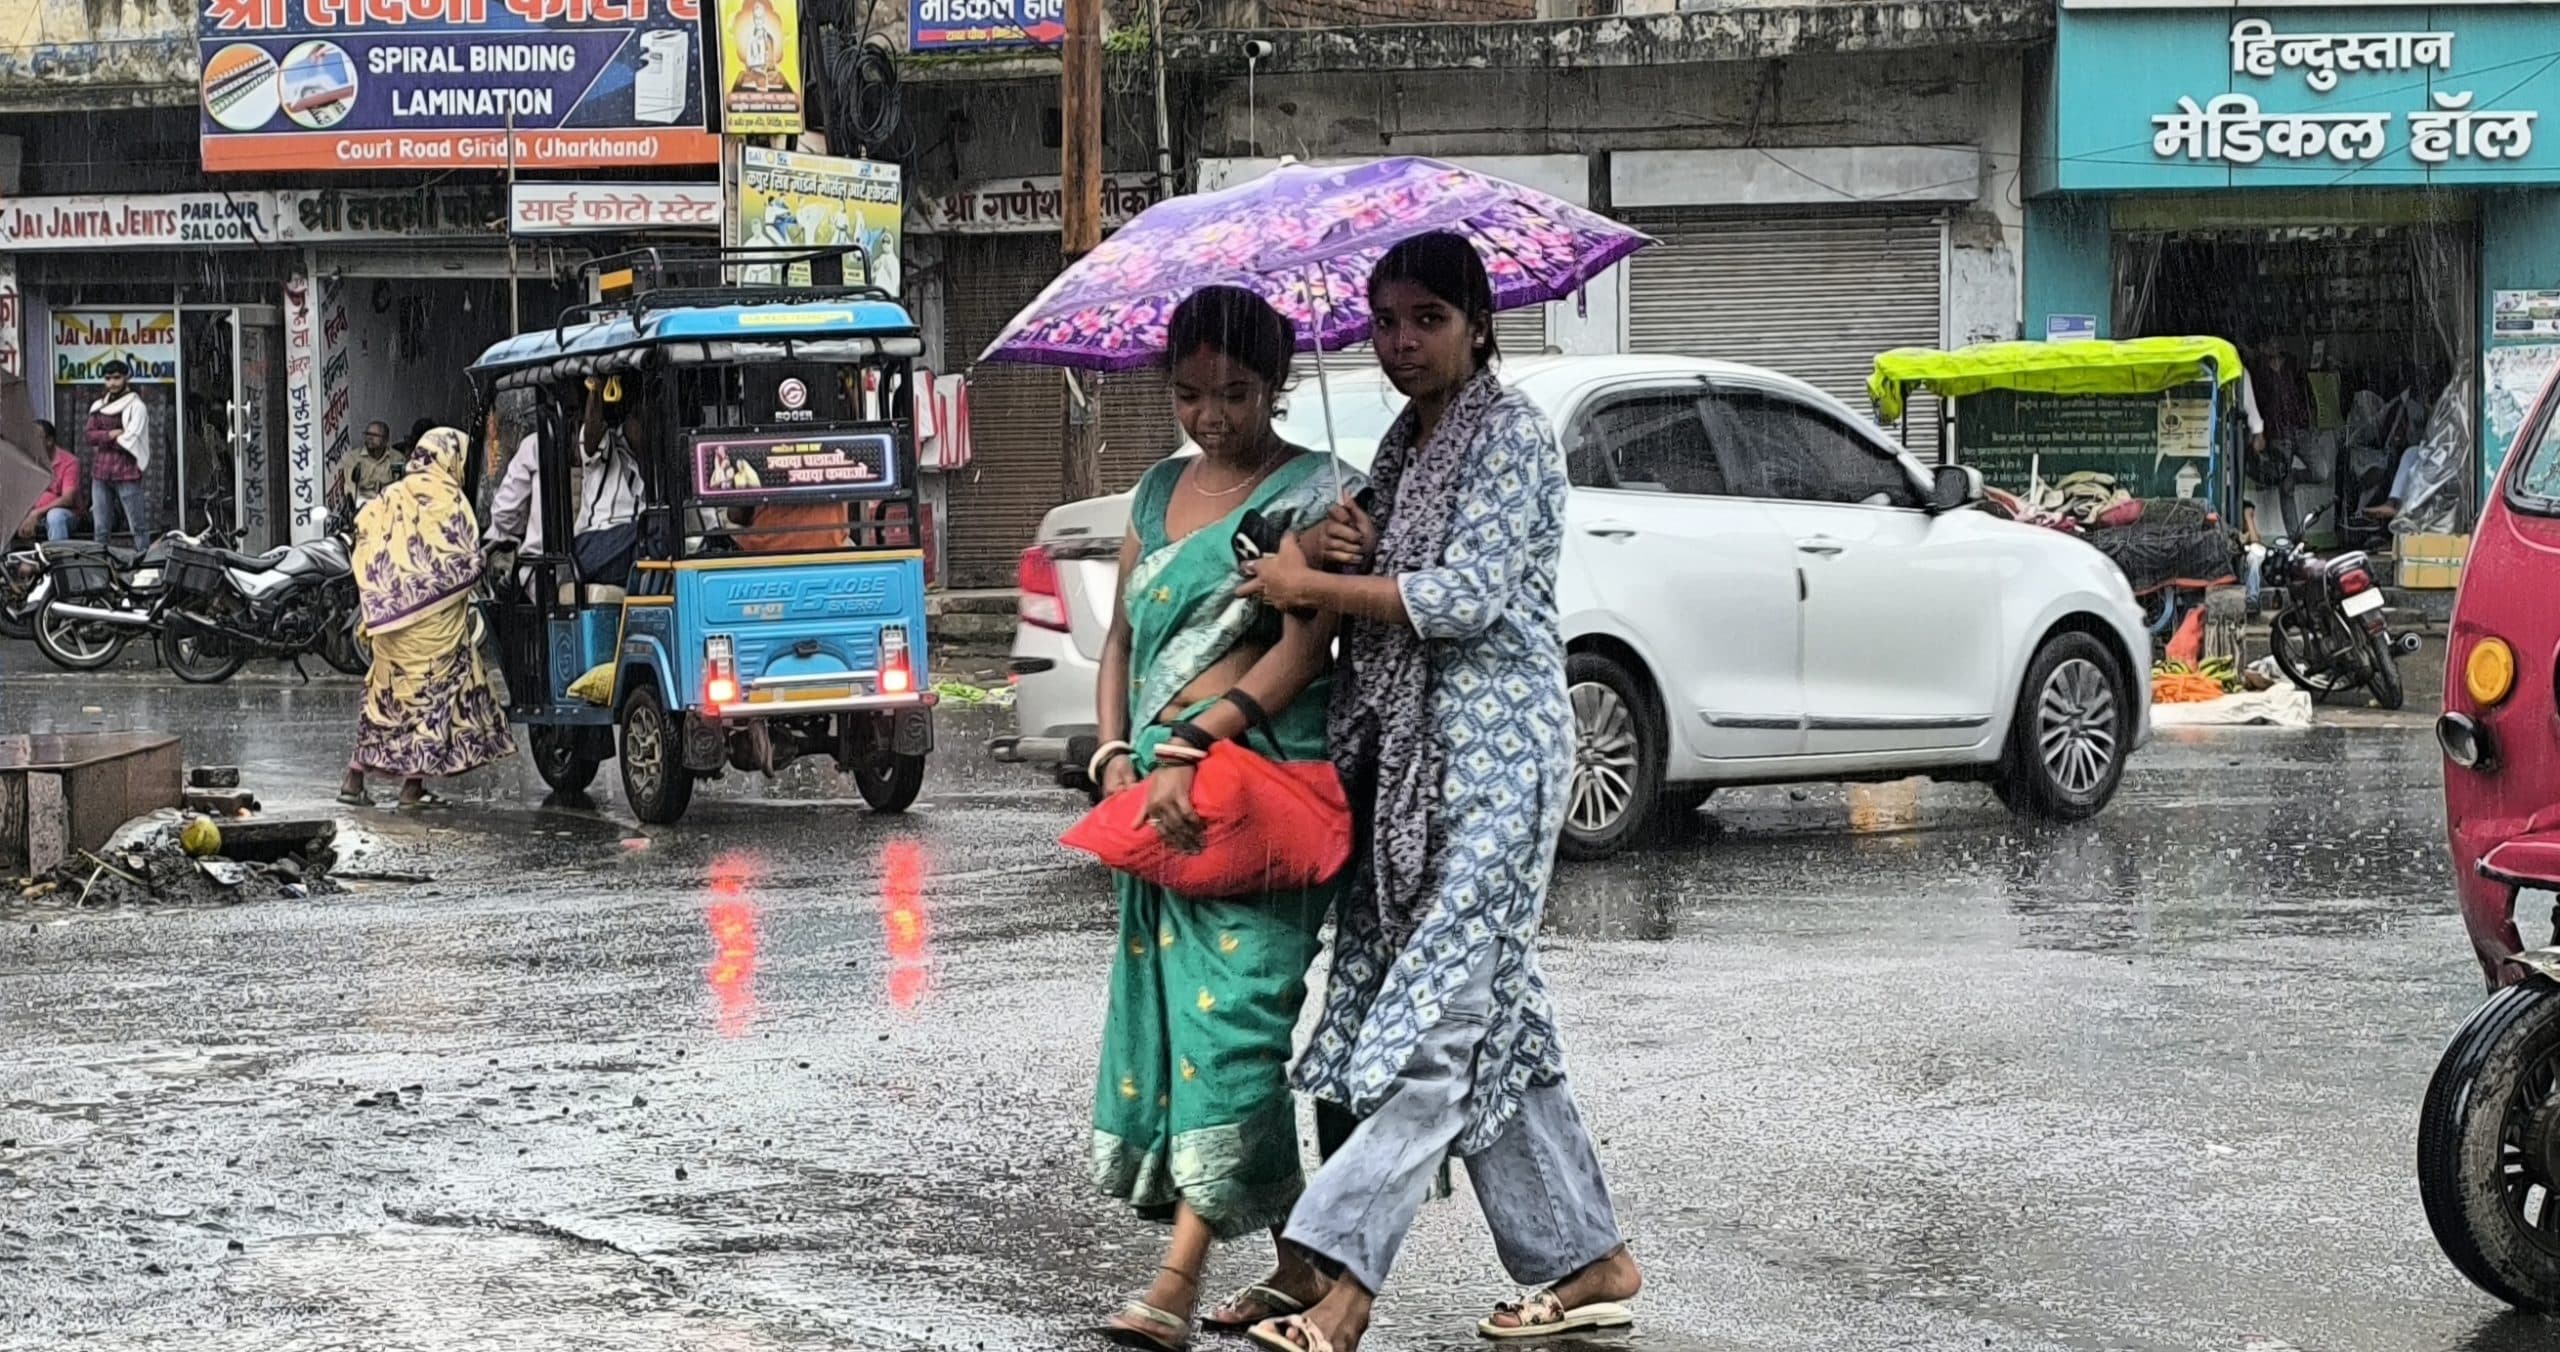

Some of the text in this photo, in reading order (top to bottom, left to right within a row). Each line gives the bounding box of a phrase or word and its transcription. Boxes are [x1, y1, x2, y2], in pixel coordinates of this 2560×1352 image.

[368, 44, 577, 75] SPIRAL BINDING
[2230, 18, 2456, 92] हिन्दुस्तान
[391, 88, 553, 117] LAMINATION
[2150, 90, 2539, 164] मेडिकल हॉल
[336, 139, 399, 161] Court
[401, 139, 452, 160] Road
[534, 137, 659, 160] (Jharkhand)
[181, 201, 264, 224] PARLOUR
[518, 191, 717, 228] साई फोटो स्टेट
[982, 180, 1062, 222] गणेश
[8, 204, 177, 239] JAI JANTA JENTS
[180, 221, 253, 241] SALOON
[55, 318, 175, 346] JAI JANTA JENTS
[58, 353, 105, 380] PARLO
[728, 581, 792, 600] INTER
